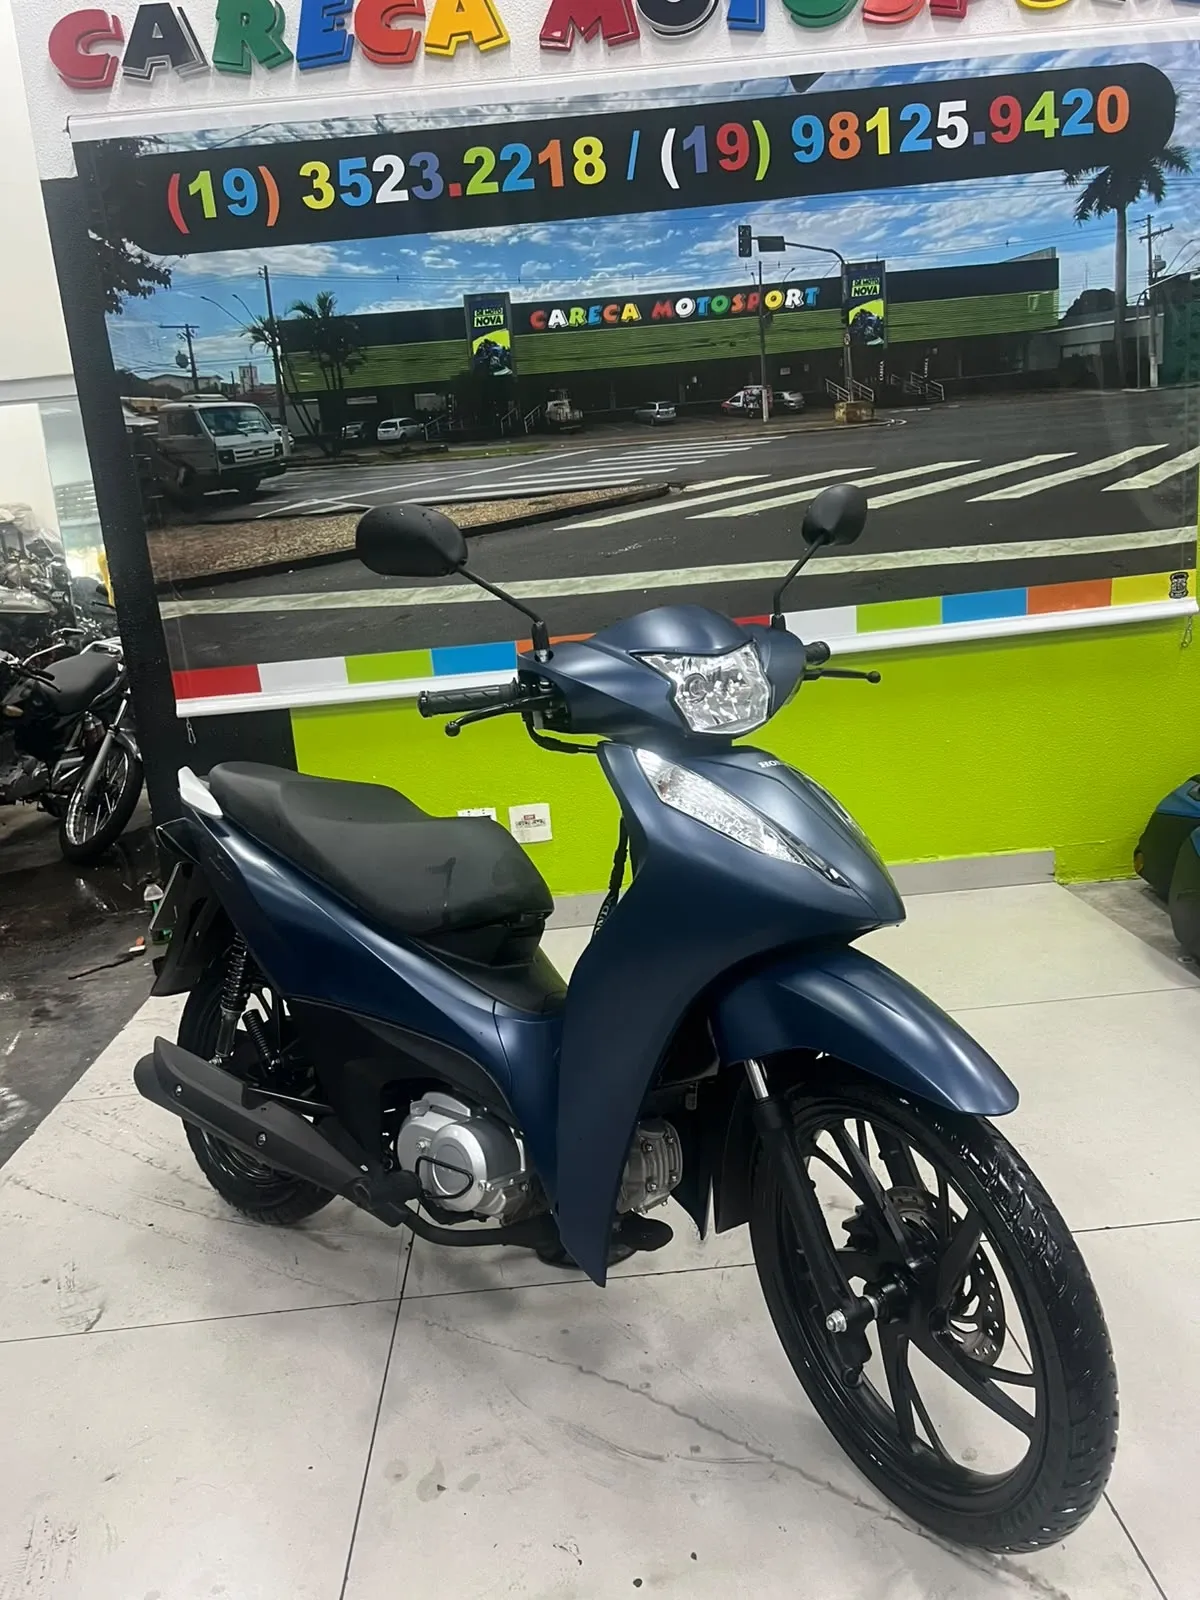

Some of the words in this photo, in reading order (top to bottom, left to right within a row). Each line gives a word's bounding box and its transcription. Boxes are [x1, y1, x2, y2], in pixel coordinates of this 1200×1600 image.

[48, 0, 510, 88] CARECA
[168, 166, 279, 234] (19)
[300, 136, 607, 210] 3523.2218
[627, 130, 641, 181] /
[661, 120, 770, 190] (19)
[792, 85, 1130, 164] 98125.9420
[529, 303, 642, 330] CARECA
[652, 287, 820, 319] MOTOSPORT
[853, 285, 878, 296] NOVA
[476, 316, 502, 326] NOVA
